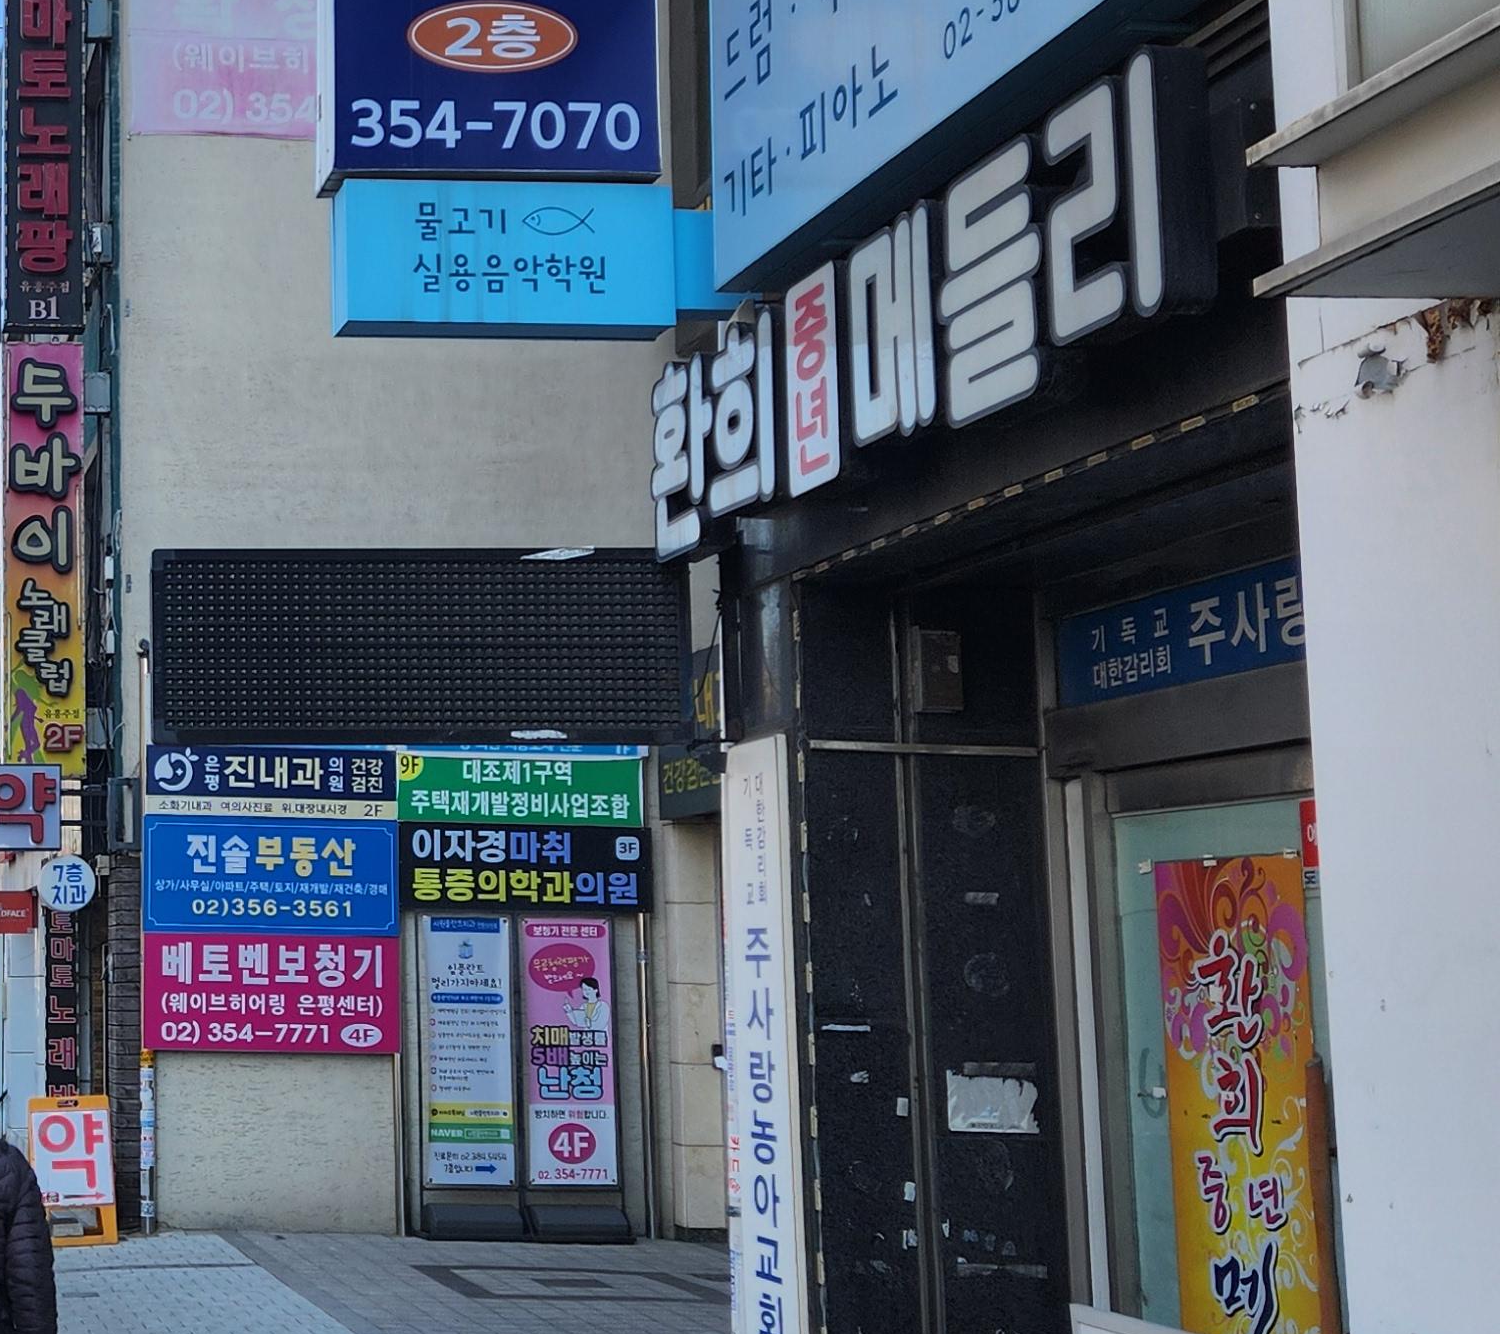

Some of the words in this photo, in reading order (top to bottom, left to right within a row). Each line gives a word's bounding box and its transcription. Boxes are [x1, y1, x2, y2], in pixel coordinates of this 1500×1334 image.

[445, 13, 540, 60] 2층
[173, 88, 234, 124] 02)
[350, 98, 640, 152] 354-7070
[415, 202, 507, 239] 물고기
[849, 51, 1164, 446] 메들리
[413, 254, 607, 297] 실용음악학원
[29, 296, 60, 319] B1
[795, 283, 827, 475] 중년
[651, 304, 775, 562] 환희
[11, 358, 81, 573] 두바이
[15, 578, 71, 697] 노래클럽
[1091, 608, 1169, 652] 기독교
[1093, 644, 1171, 689] 대한감리회
[46, 724, 82, 748] 2F
[204, 755, 220, 791] 은평
[223, 755, 324, 790] 진내과
[328, 757, 344, 793] 의원
[351, 758, 383, 776] 건강
[400, 756, 420, 774] 9F
[462, 759, 573, 785] 대조제1구역
[351, 776, 383, 794] 검진
[159, 800, 212, 812] 소화기내과
[221, 801, 273, 813] 여의사진료
[364, 804, 383, 817] 2F
[411, 790, 630, 819] 주택재개발정비사업조합
[186, 834, 357, 877] 진솔부동산
[412, 828, 571, 864] 이자경마취
[619, 841, 636, 854] 3F
[53, 863, 82, 883] 7층
[412, 868, 638, 905] 통증의학과의원
[52, 884, 86, 905] 치과
[192, 898, 352, 918] 02)356-3561
[161, 941, 383, 988] 베토벤보청기
[161, 992, 286, 1015] (웨이브히어링
[297, 994, 382, 1017] 은평센터)
[160, 1020, 200, 1044] 02)
[348, 1028, 374, 1043] 4F
[538, 1067, 603, 1100] 난청
[430, 1129, 463, 1138] NAVER
[553, 1132, 589, 1157] 4F
[38, 1114, 104, 1189] 약
[555, 1168, 608, 1180] 354-7771
